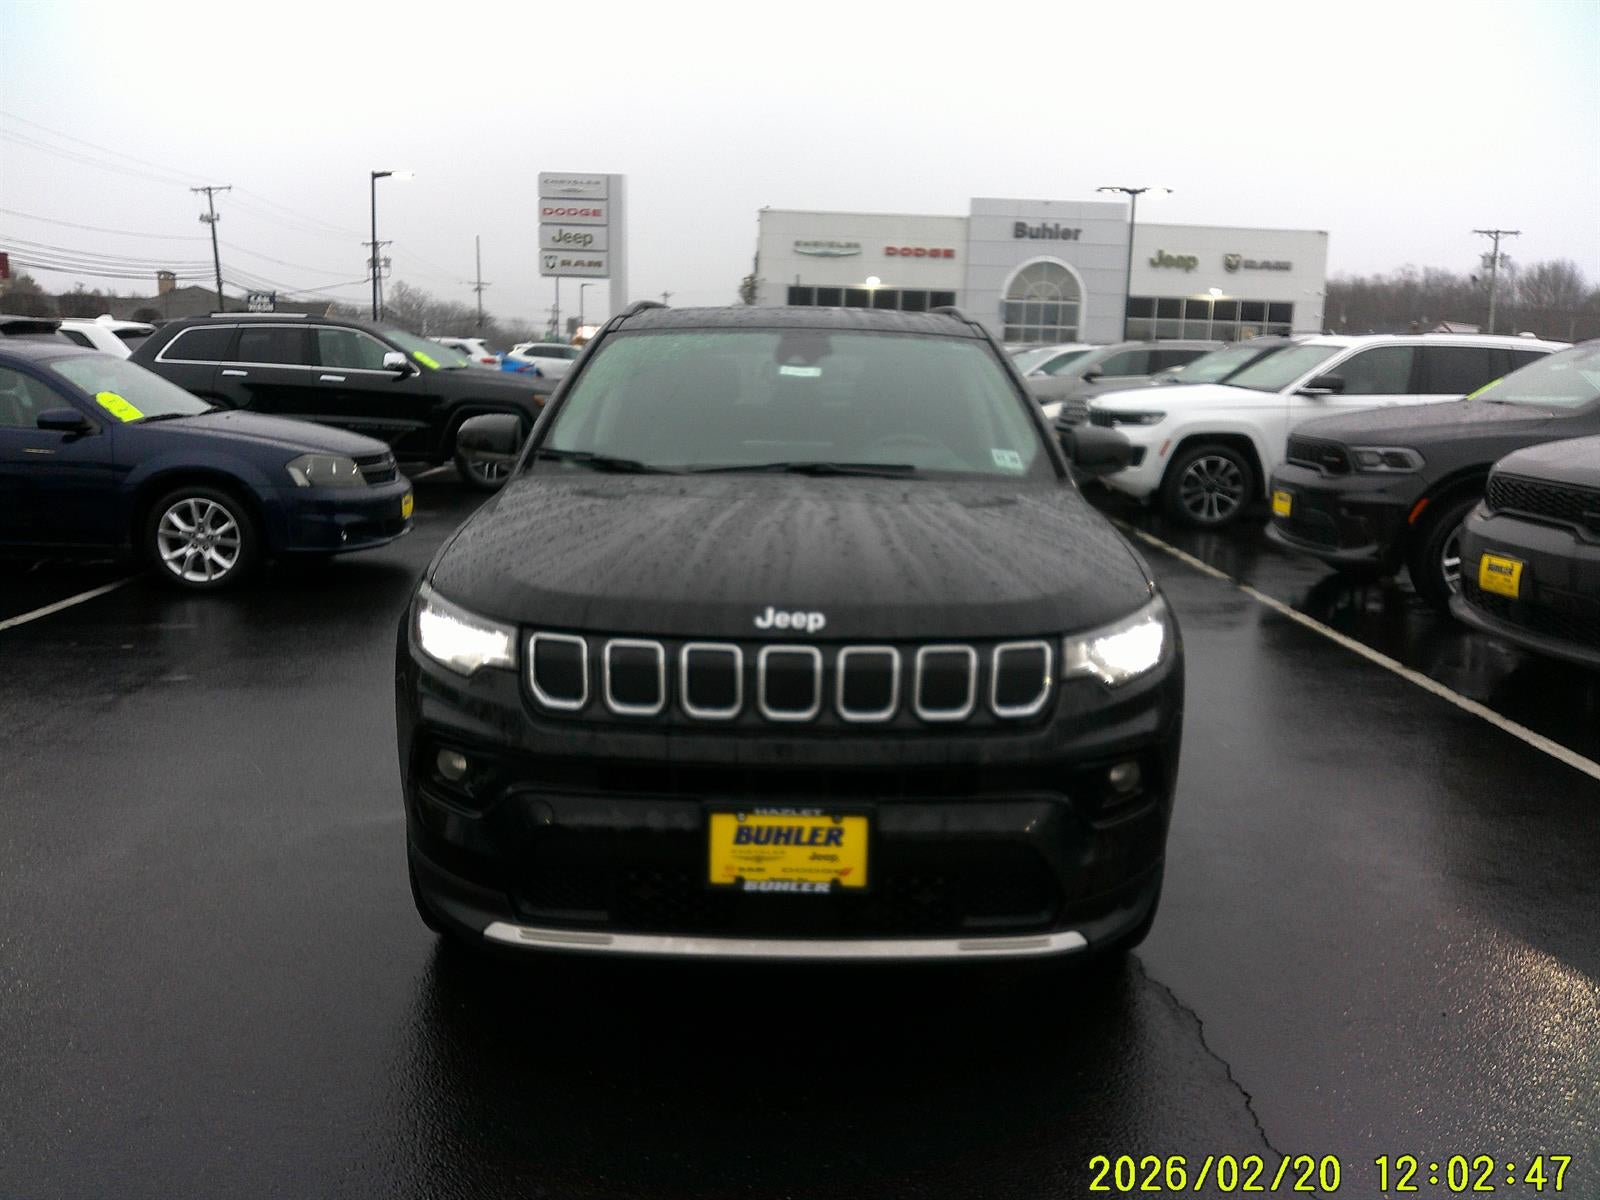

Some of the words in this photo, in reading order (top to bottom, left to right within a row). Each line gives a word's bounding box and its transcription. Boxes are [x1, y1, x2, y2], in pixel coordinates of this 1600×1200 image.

[542, 207, 602, 217] DODGE
[551, 228, 594, 247] Jeep
[1013, 221, 1082, 241] Buhler
[885, 245, 956, 259] DODGE
[1149, 249, 1199, 273] Jeep
[753, 605, 826, 634] Jeep
[733, 824, 844, 847] BUHLER
[742, 879, 832, 893] BUHLER
